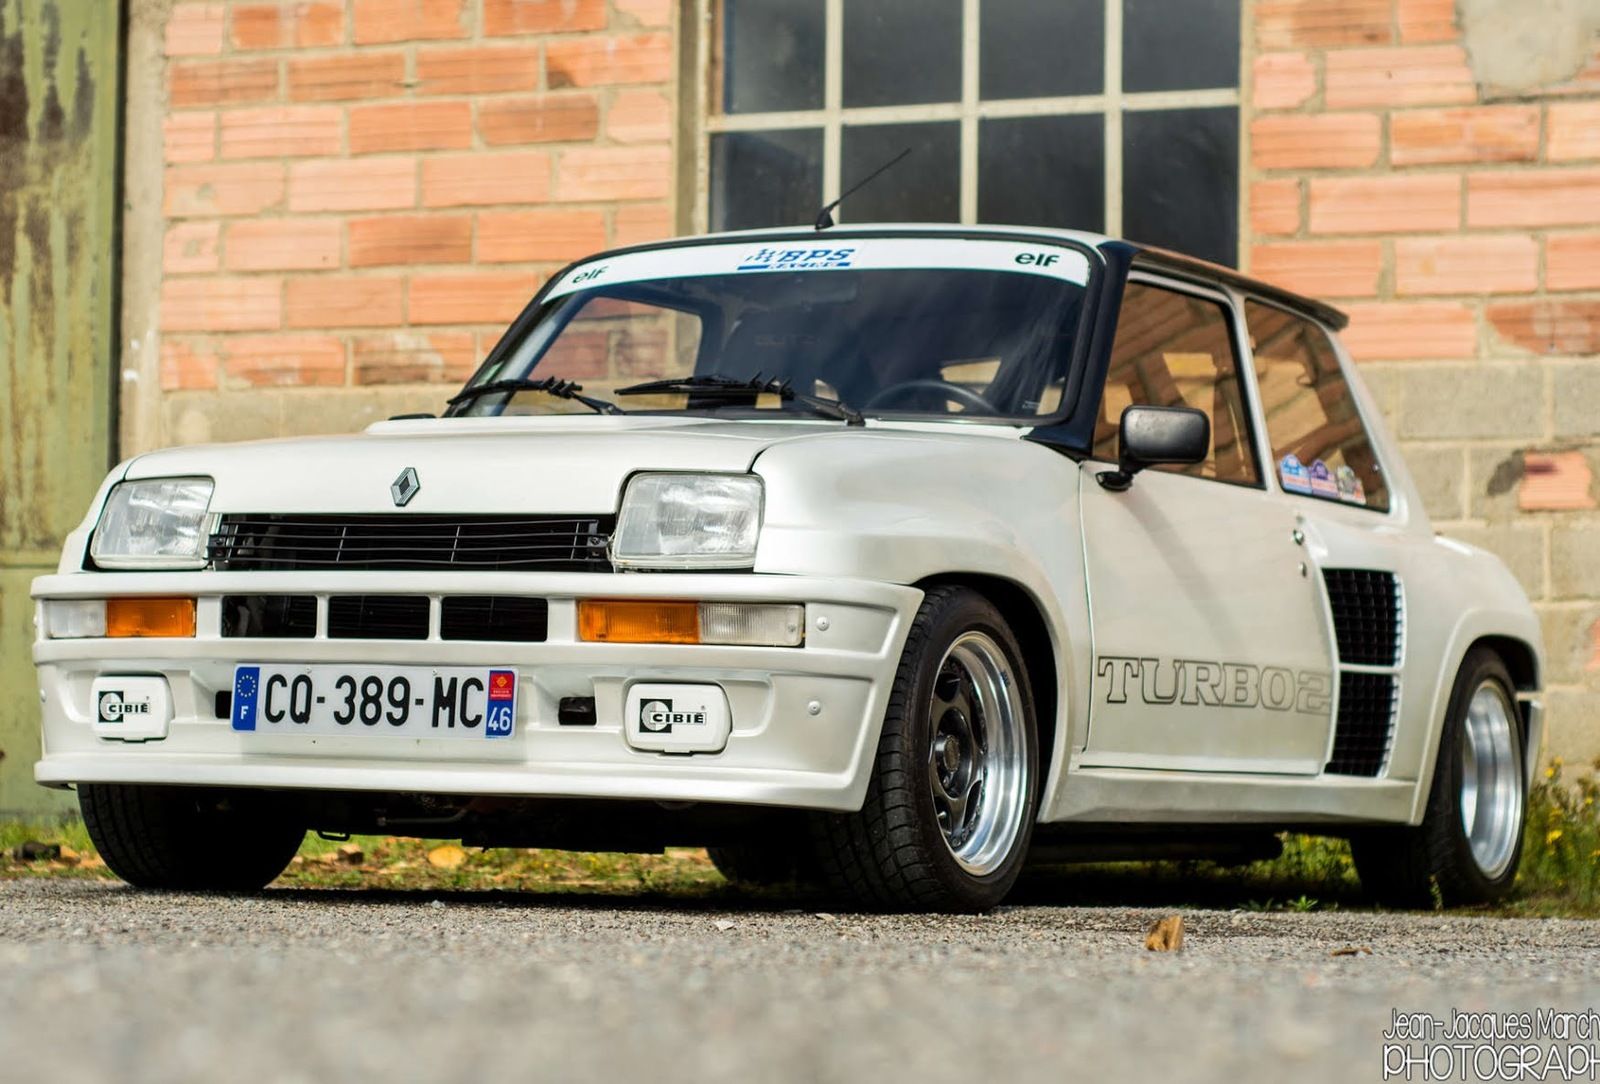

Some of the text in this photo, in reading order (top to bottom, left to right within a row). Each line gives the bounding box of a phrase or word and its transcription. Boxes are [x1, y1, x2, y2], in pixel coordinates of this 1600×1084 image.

[777, 249, 855, 262] BPS
[1015, 253, 1060, 267] elf
[572, 265, 609, 284] elf
[240, 673, 511, 731] F CQ-389-MC 46
